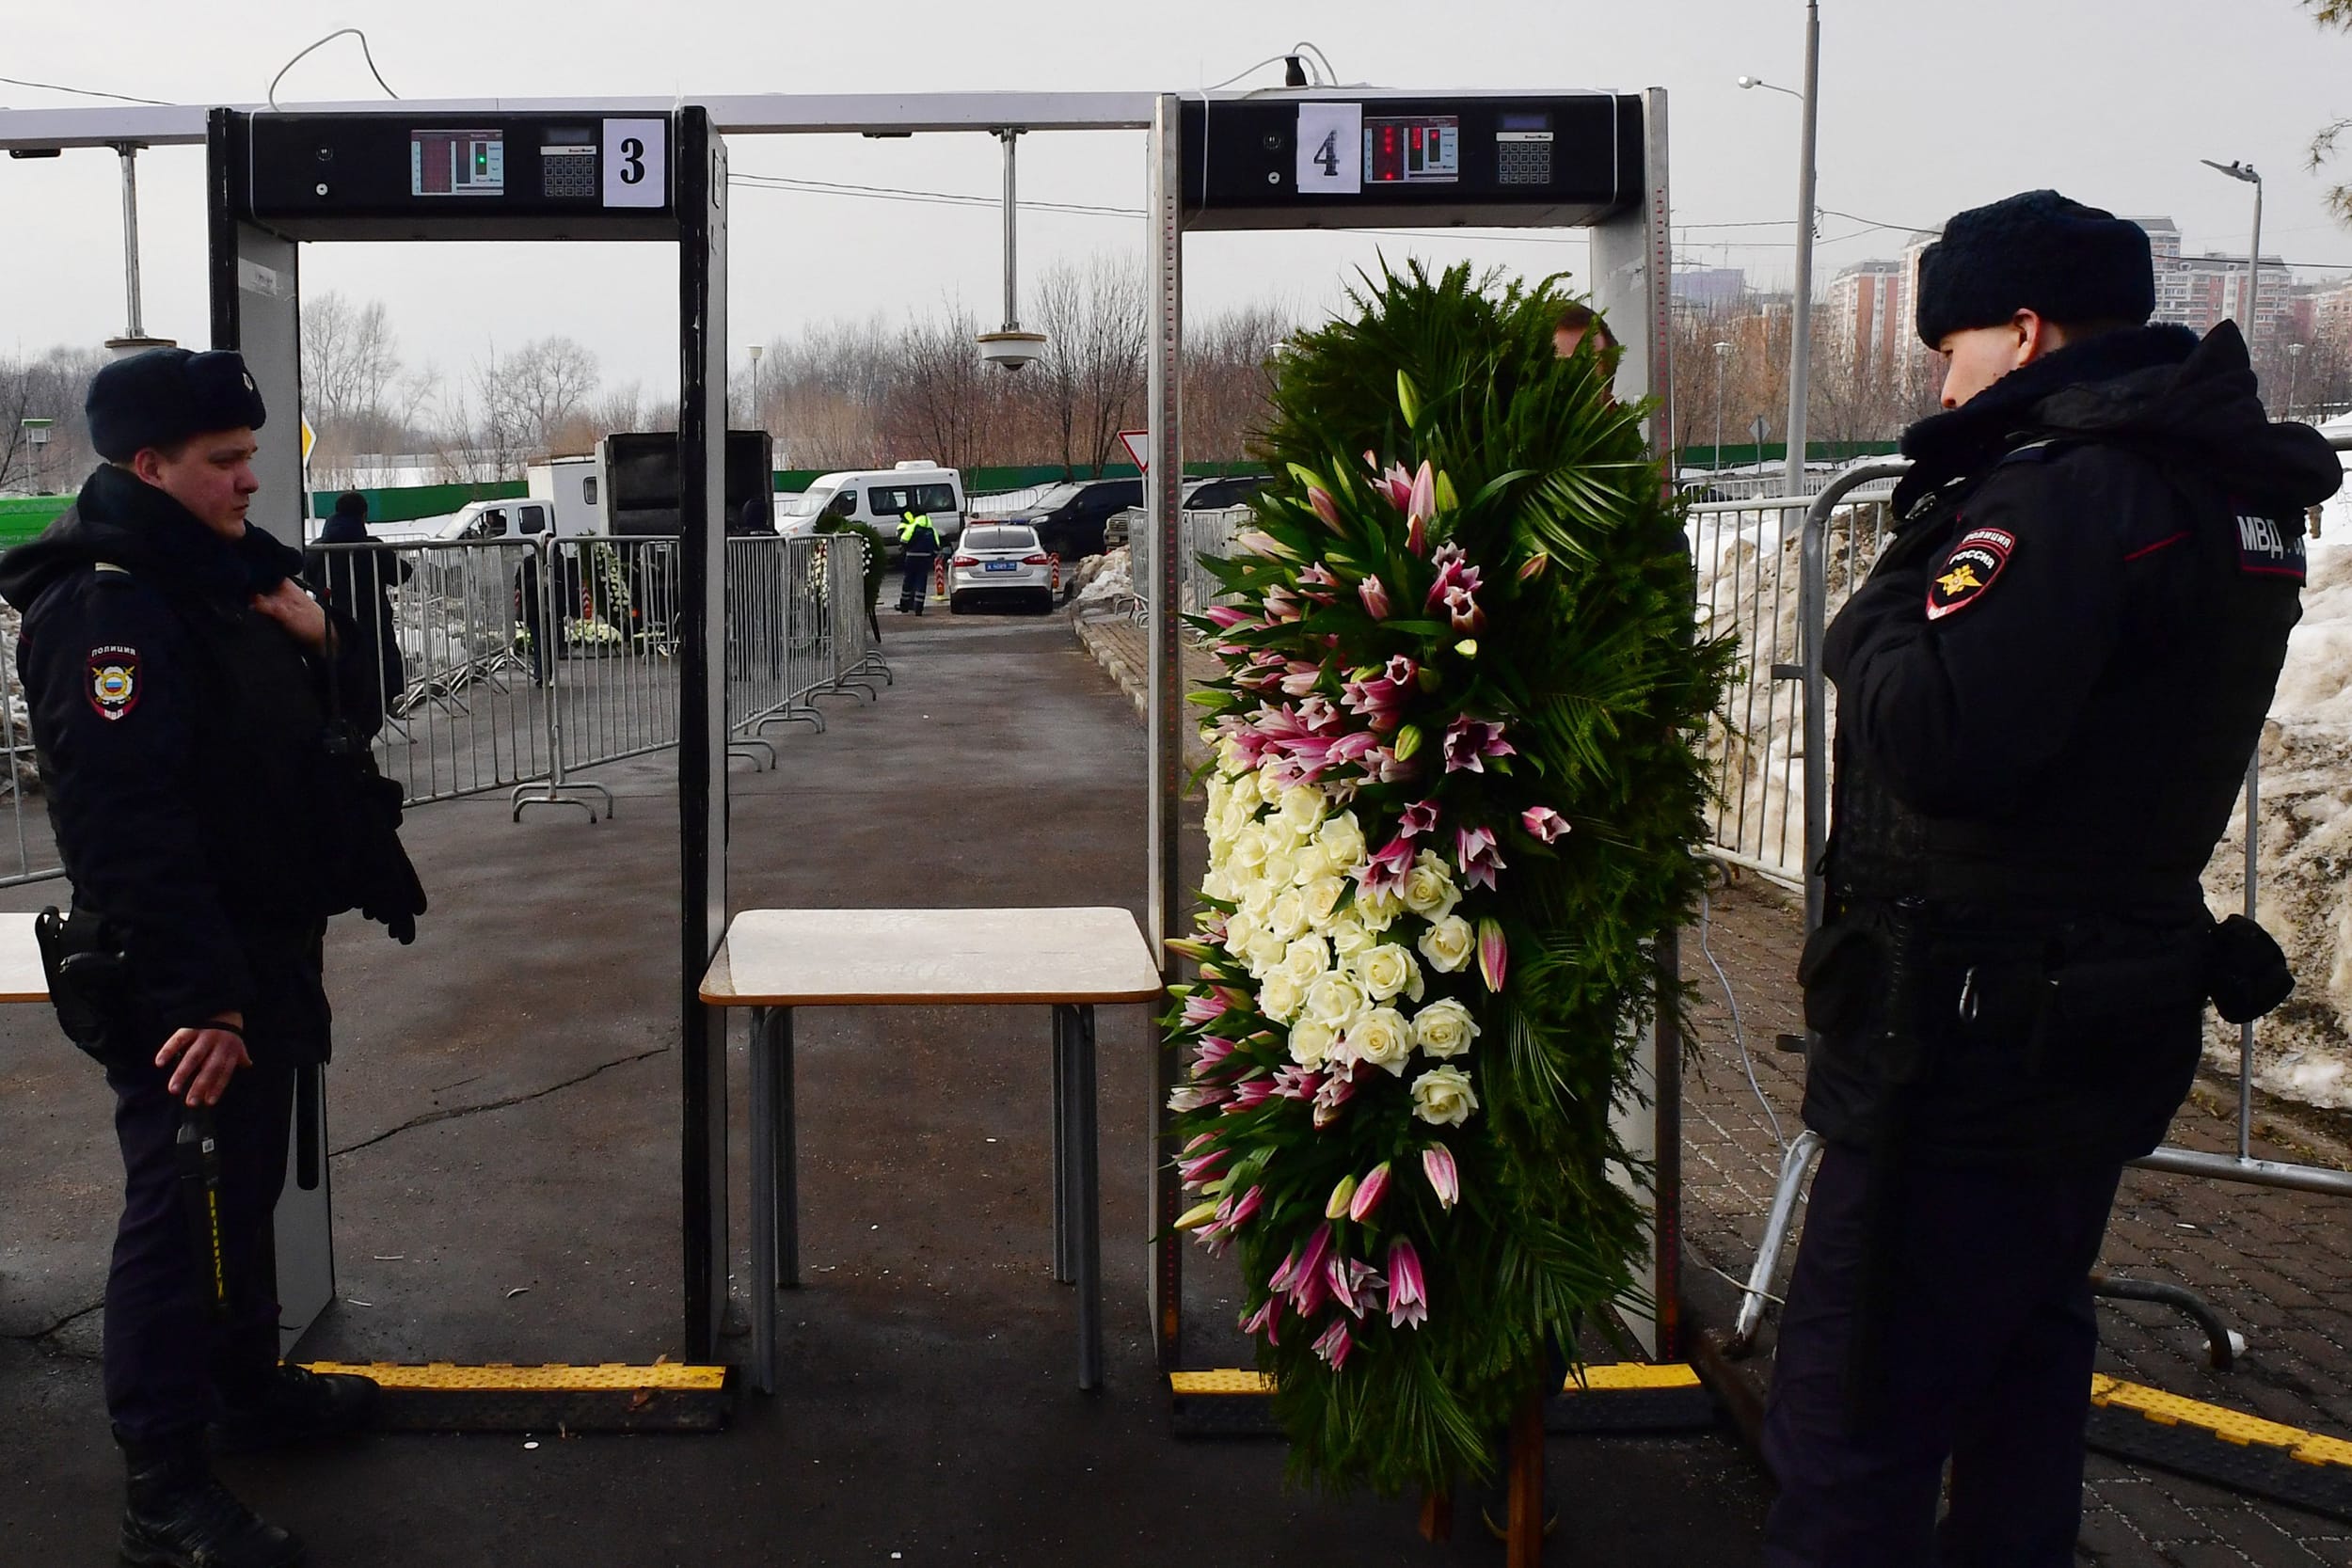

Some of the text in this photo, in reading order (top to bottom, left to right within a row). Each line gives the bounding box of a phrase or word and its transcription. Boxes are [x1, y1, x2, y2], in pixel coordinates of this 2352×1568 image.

[620, 138, 644, 184] 3
[1313, 130, 1340, 176] 4
[1963, 531, 2010, 547] ПОЛИЦИЯ
[2236, 515, 2283, 560] МВД
[1949, 550, 1994, 568] РОССИЯ
[91, 646, 135, 657] ПОЛИЦИЯ
